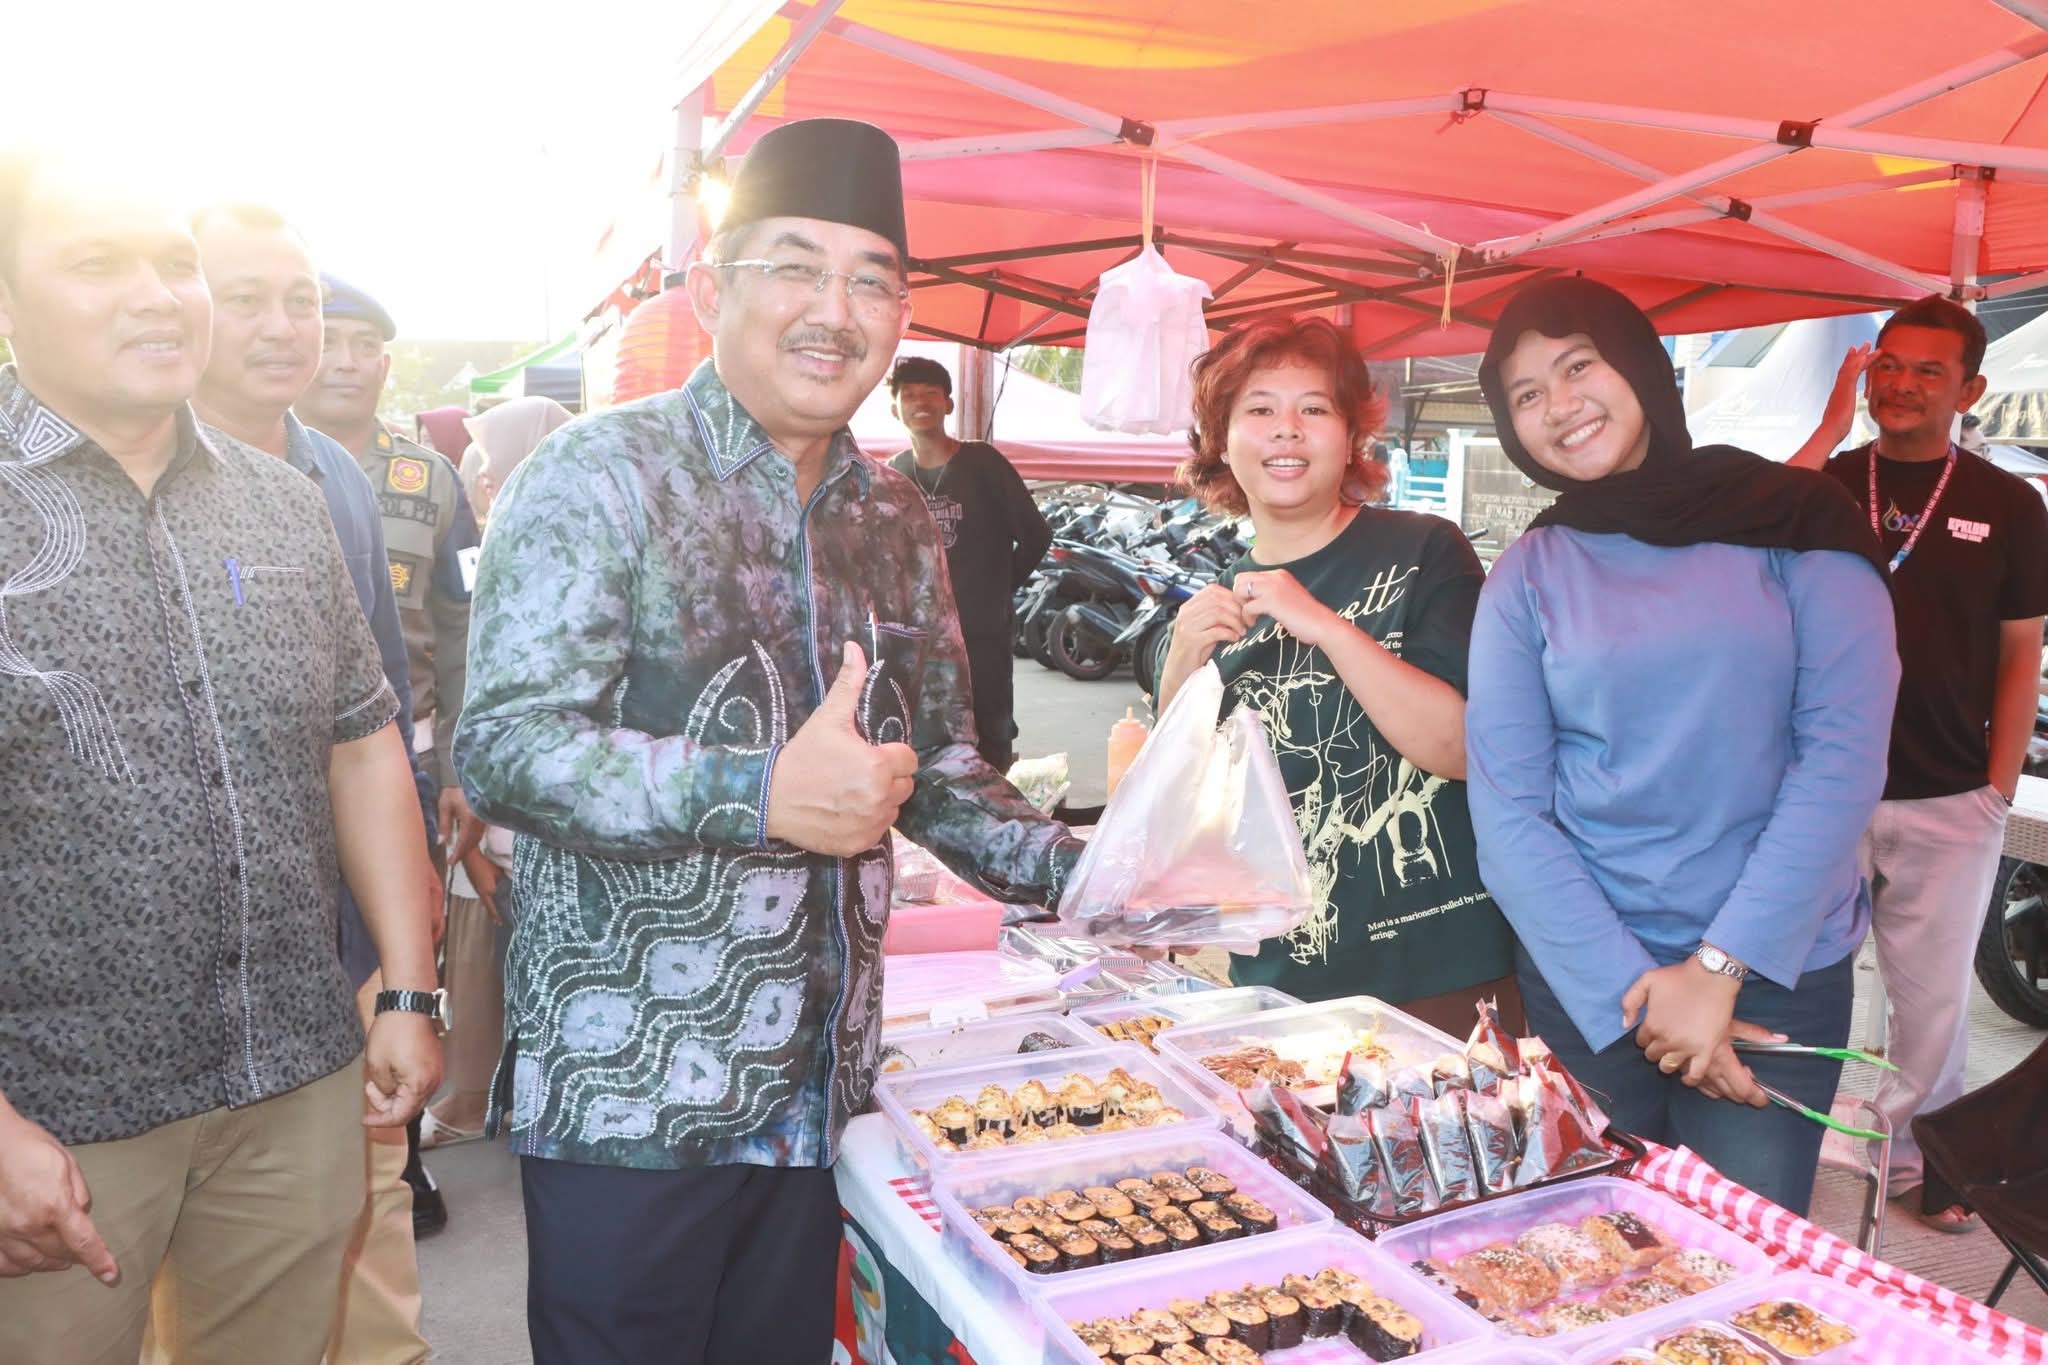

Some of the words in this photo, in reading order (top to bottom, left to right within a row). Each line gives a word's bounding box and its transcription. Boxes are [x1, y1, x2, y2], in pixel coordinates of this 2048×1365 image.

[1367, 921, 1386, 932] Man
[1387, 918, 1394, 927] is
[1394, 918, 1400, 926] a
[1440, 896, 1464, 914] pulled
[1464, 892, 1474, 905] by
[1370, 928, 1399, 942] strings.
